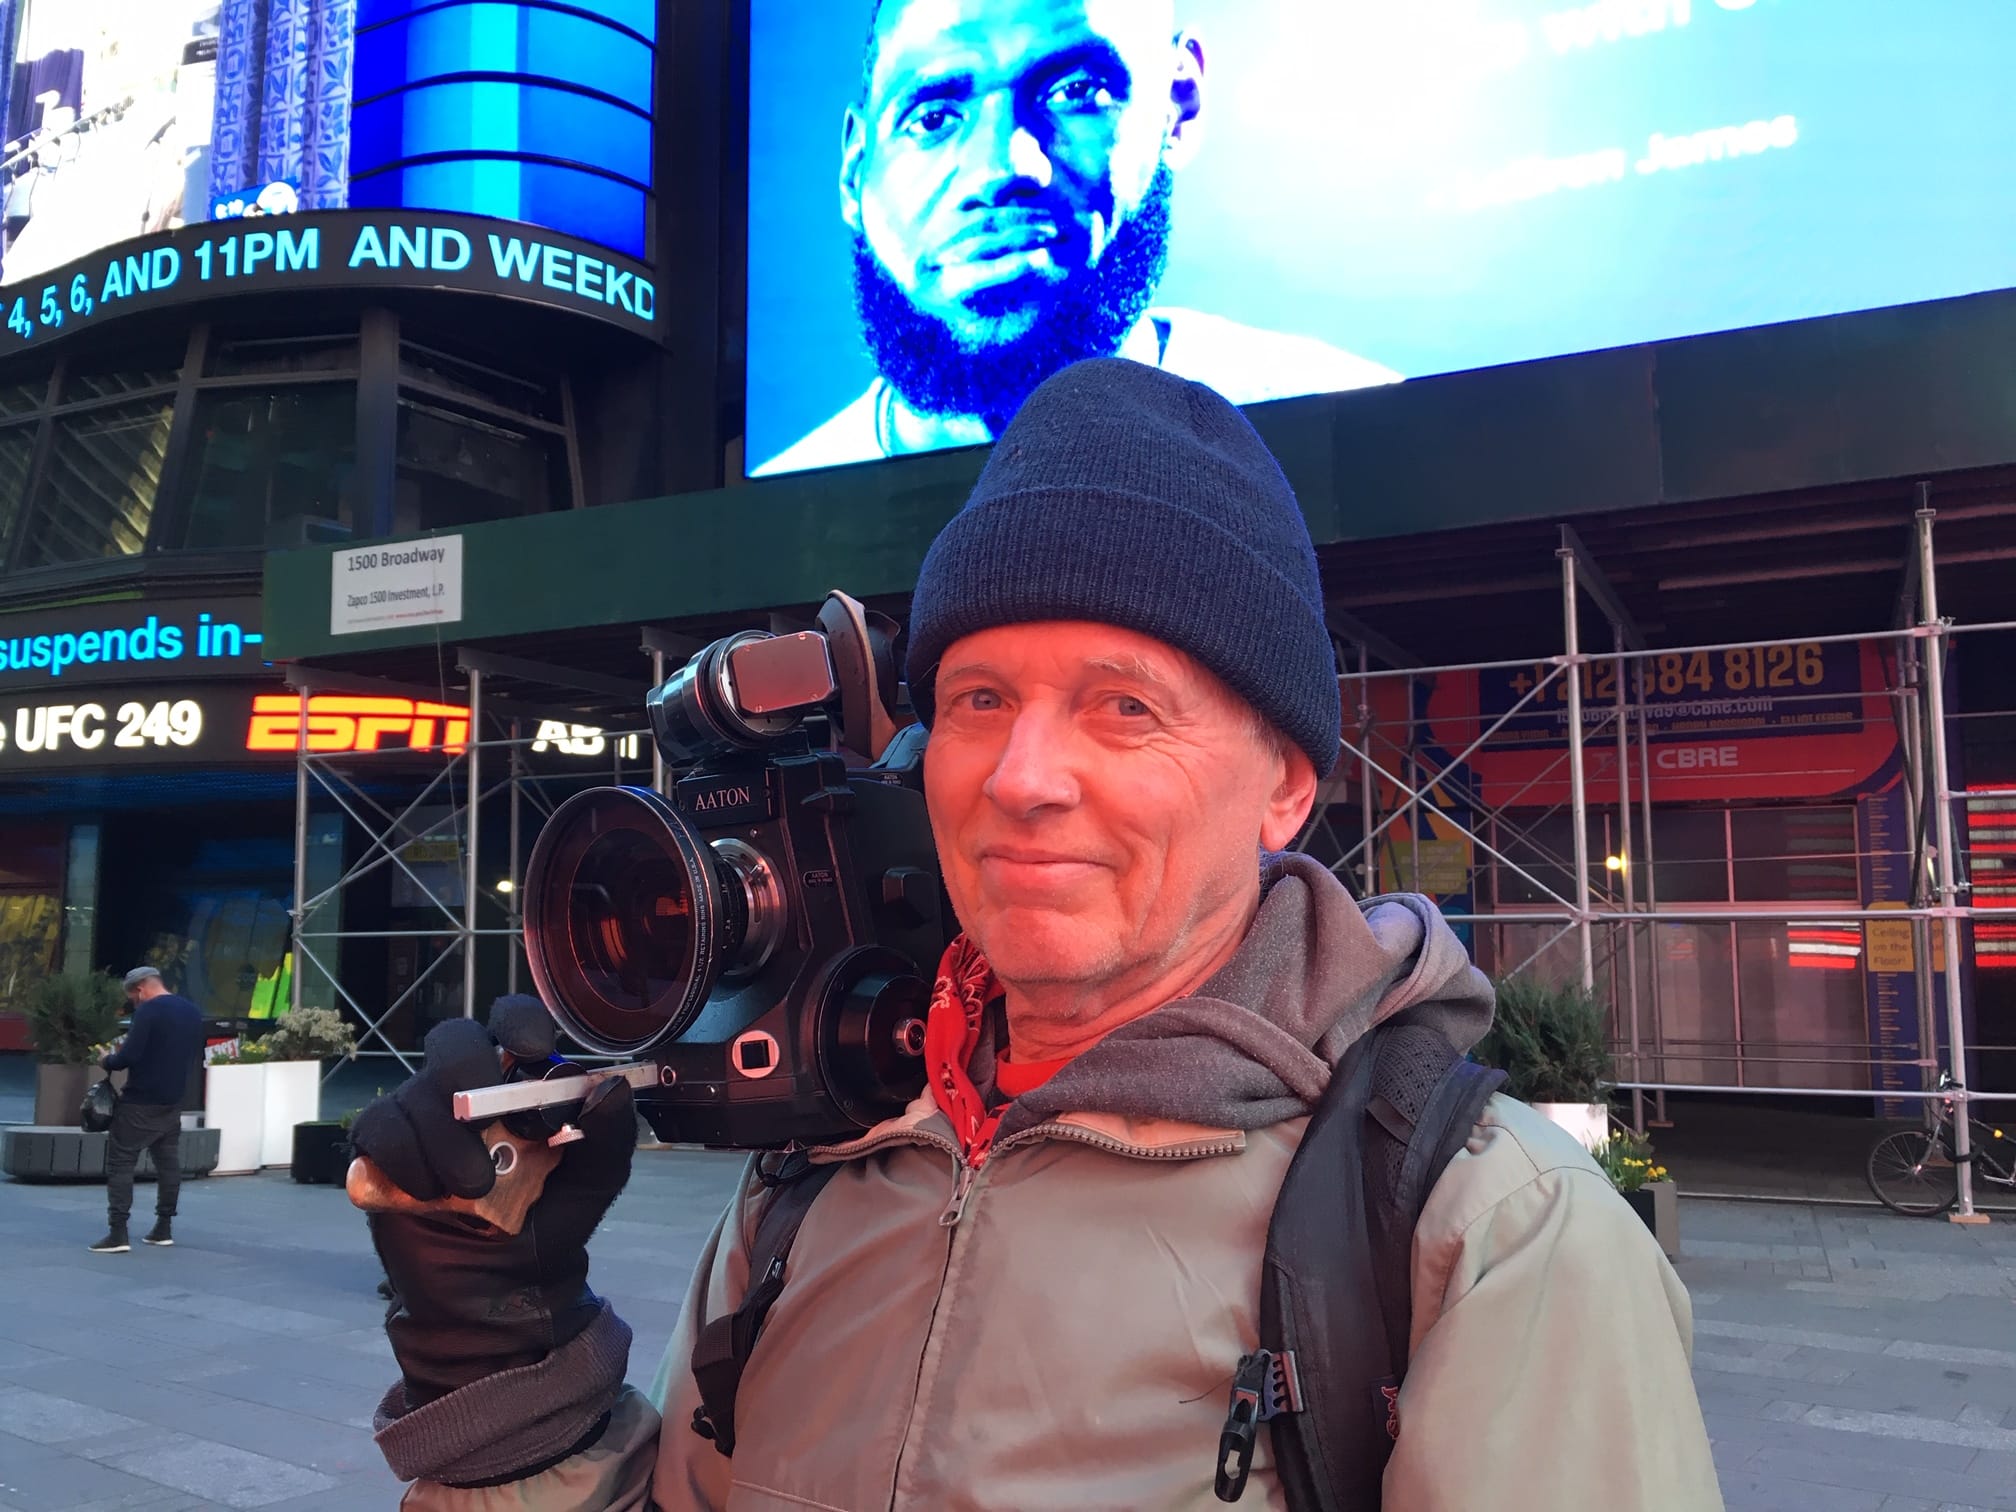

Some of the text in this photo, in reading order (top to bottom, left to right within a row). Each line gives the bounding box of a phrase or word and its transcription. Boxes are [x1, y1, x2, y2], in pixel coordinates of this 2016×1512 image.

[7, 226, 655, 338] 4, 5, 6, AND 11PM AND WEEKD
[348, 547, 445, 571] 1500 Broadway
[369, 589, 387, 604] 1500
[0, 616, 185, 676] suspends
[1724, 643, 1825, 690] 8126
[15, 699, 203, 752] UFC 249
[246, 694, 469, 755] ESPN
[1656, 746, 1739, 769] CBRE
[695, 786, 751, 811] AATON
